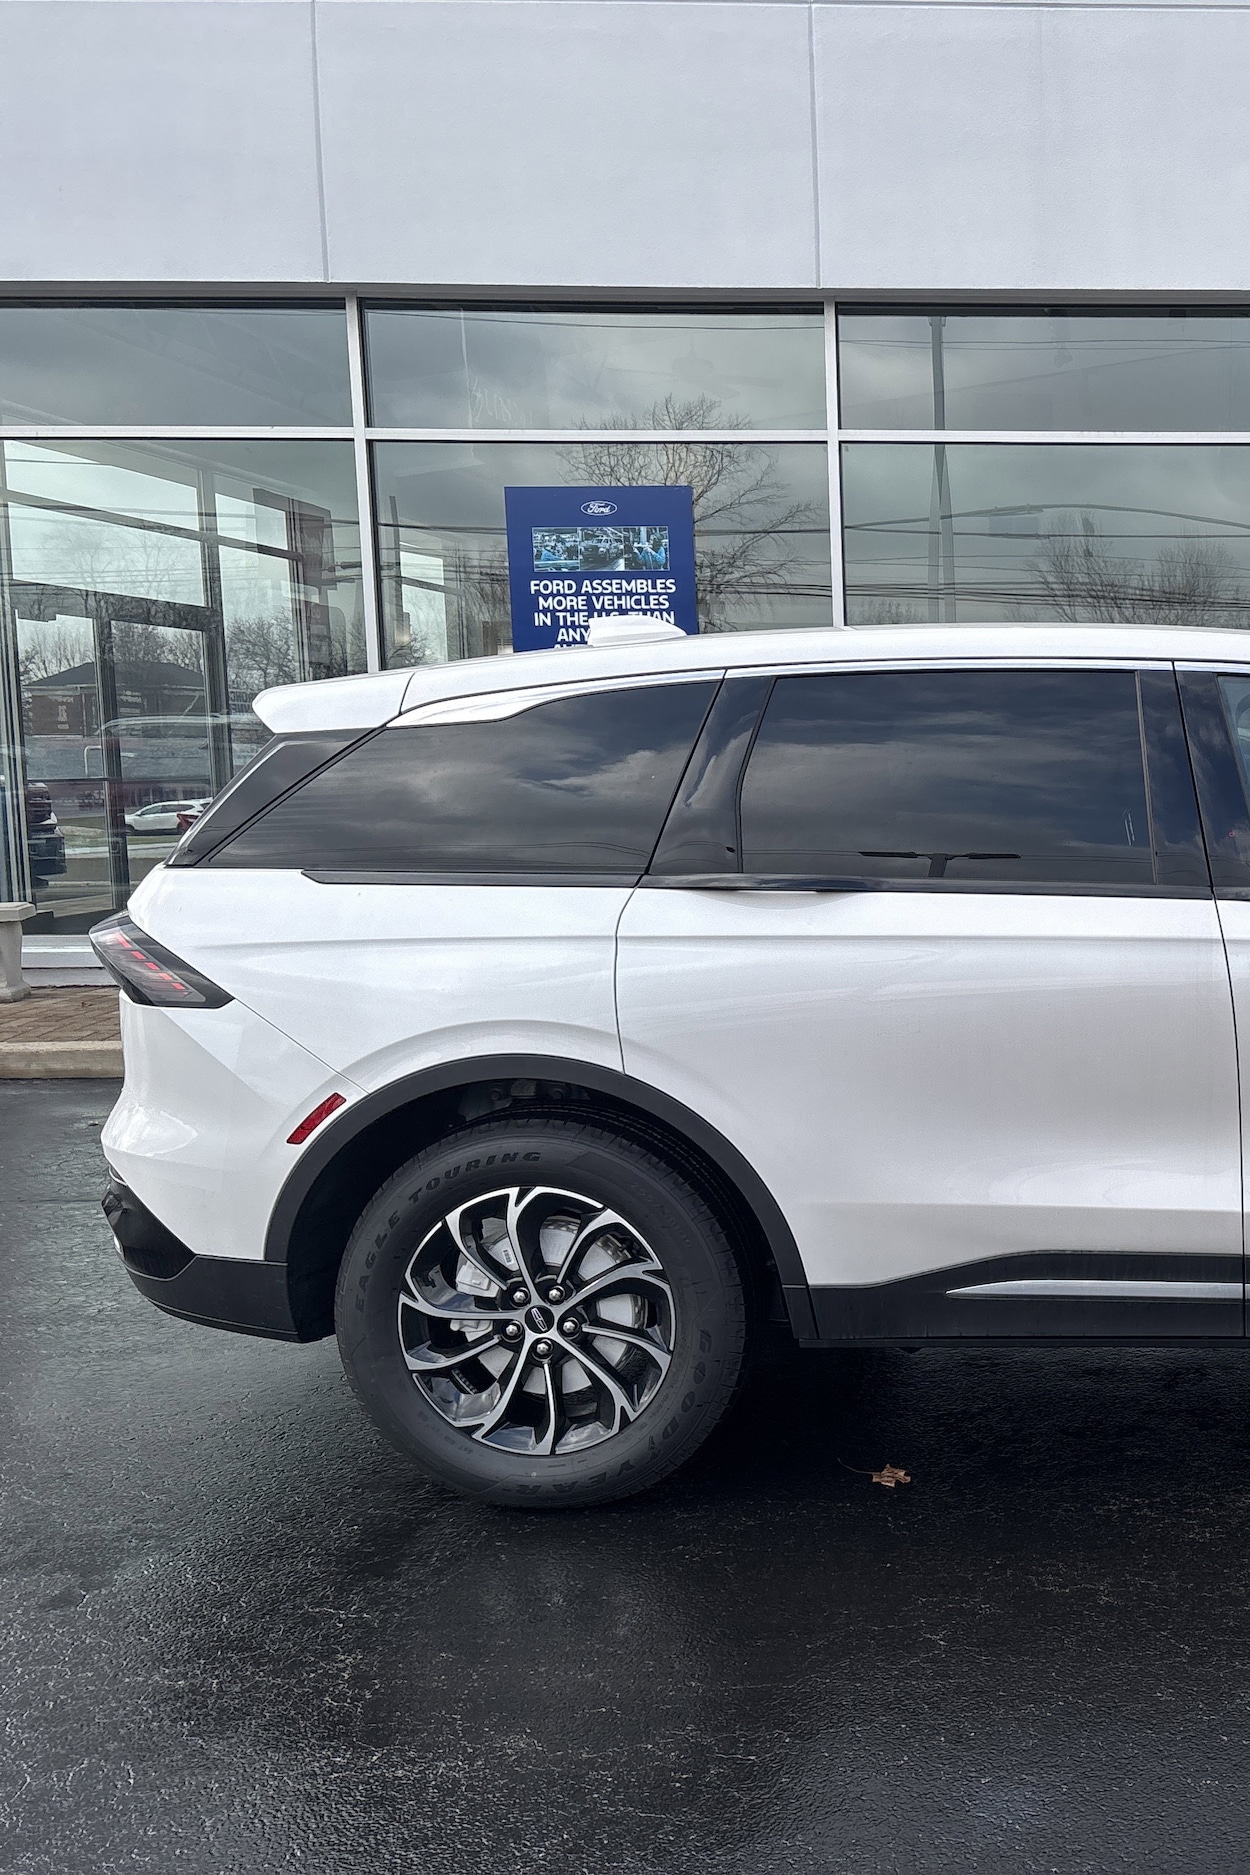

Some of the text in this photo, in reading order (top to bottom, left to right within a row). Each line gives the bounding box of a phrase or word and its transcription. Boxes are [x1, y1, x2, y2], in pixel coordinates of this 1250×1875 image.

[530, 579, 676, 594] FORD ASSEMBLES
[538, 595, 669, 610] MORE VEHICLES
[534, 612, 551, 626] IN
[556, 612, 589, 626] THE
[557, 628, 590, 642] ANY
[355, 1150, 542, 1312] EAGLE TOURING
